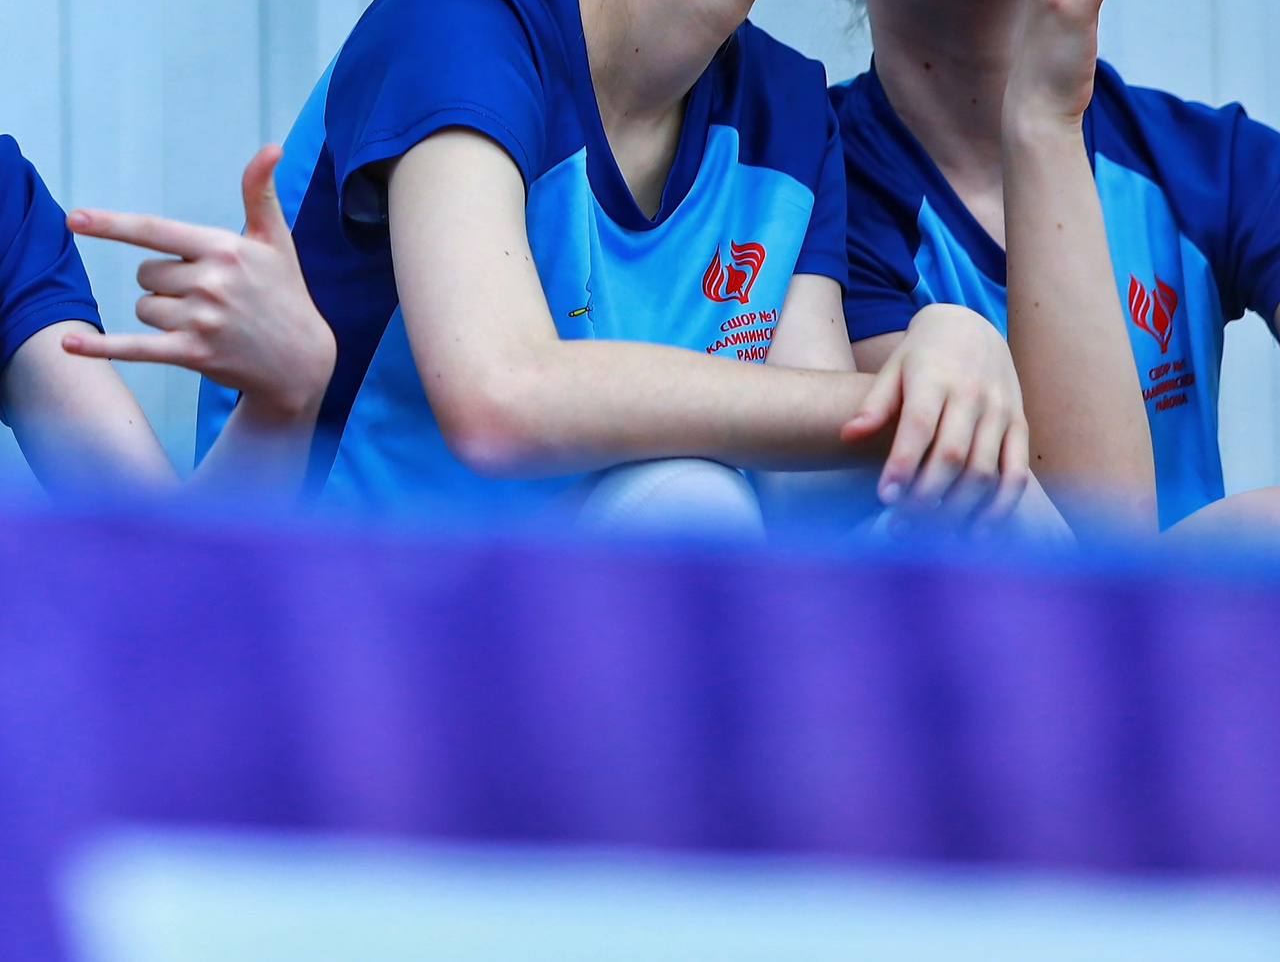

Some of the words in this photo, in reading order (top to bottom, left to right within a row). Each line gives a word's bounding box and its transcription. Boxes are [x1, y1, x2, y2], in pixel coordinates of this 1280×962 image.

[720, 312, 756, 332] СШОР
[759, 309, 777, 323] №1
[706, 327, 775, 354] КАЛИНИНСК
